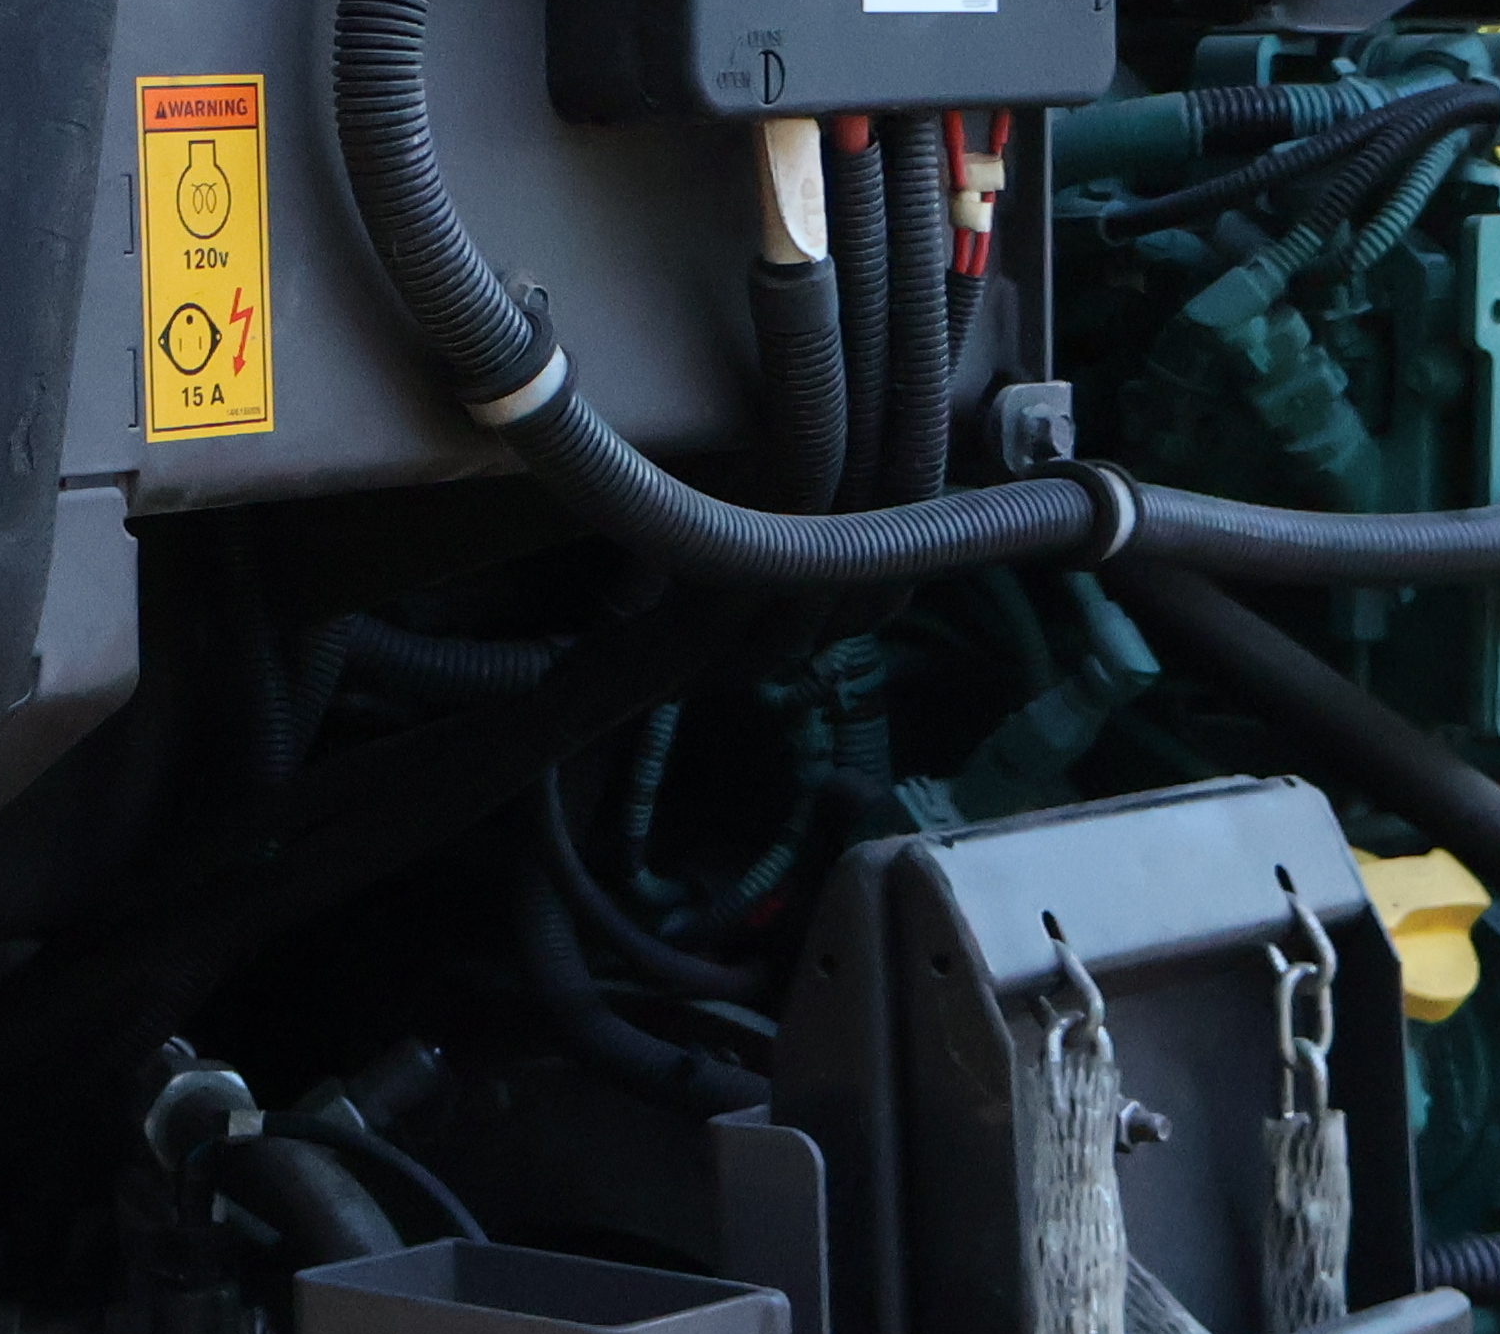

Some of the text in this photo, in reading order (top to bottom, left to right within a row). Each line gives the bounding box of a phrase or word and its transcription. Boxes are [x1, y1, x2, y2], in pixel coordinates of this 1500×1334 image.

[167, 97, 248, 119] WARNING
[183, 247, 229, 270] 120v
[180, 383, 225, 407] 15 A
